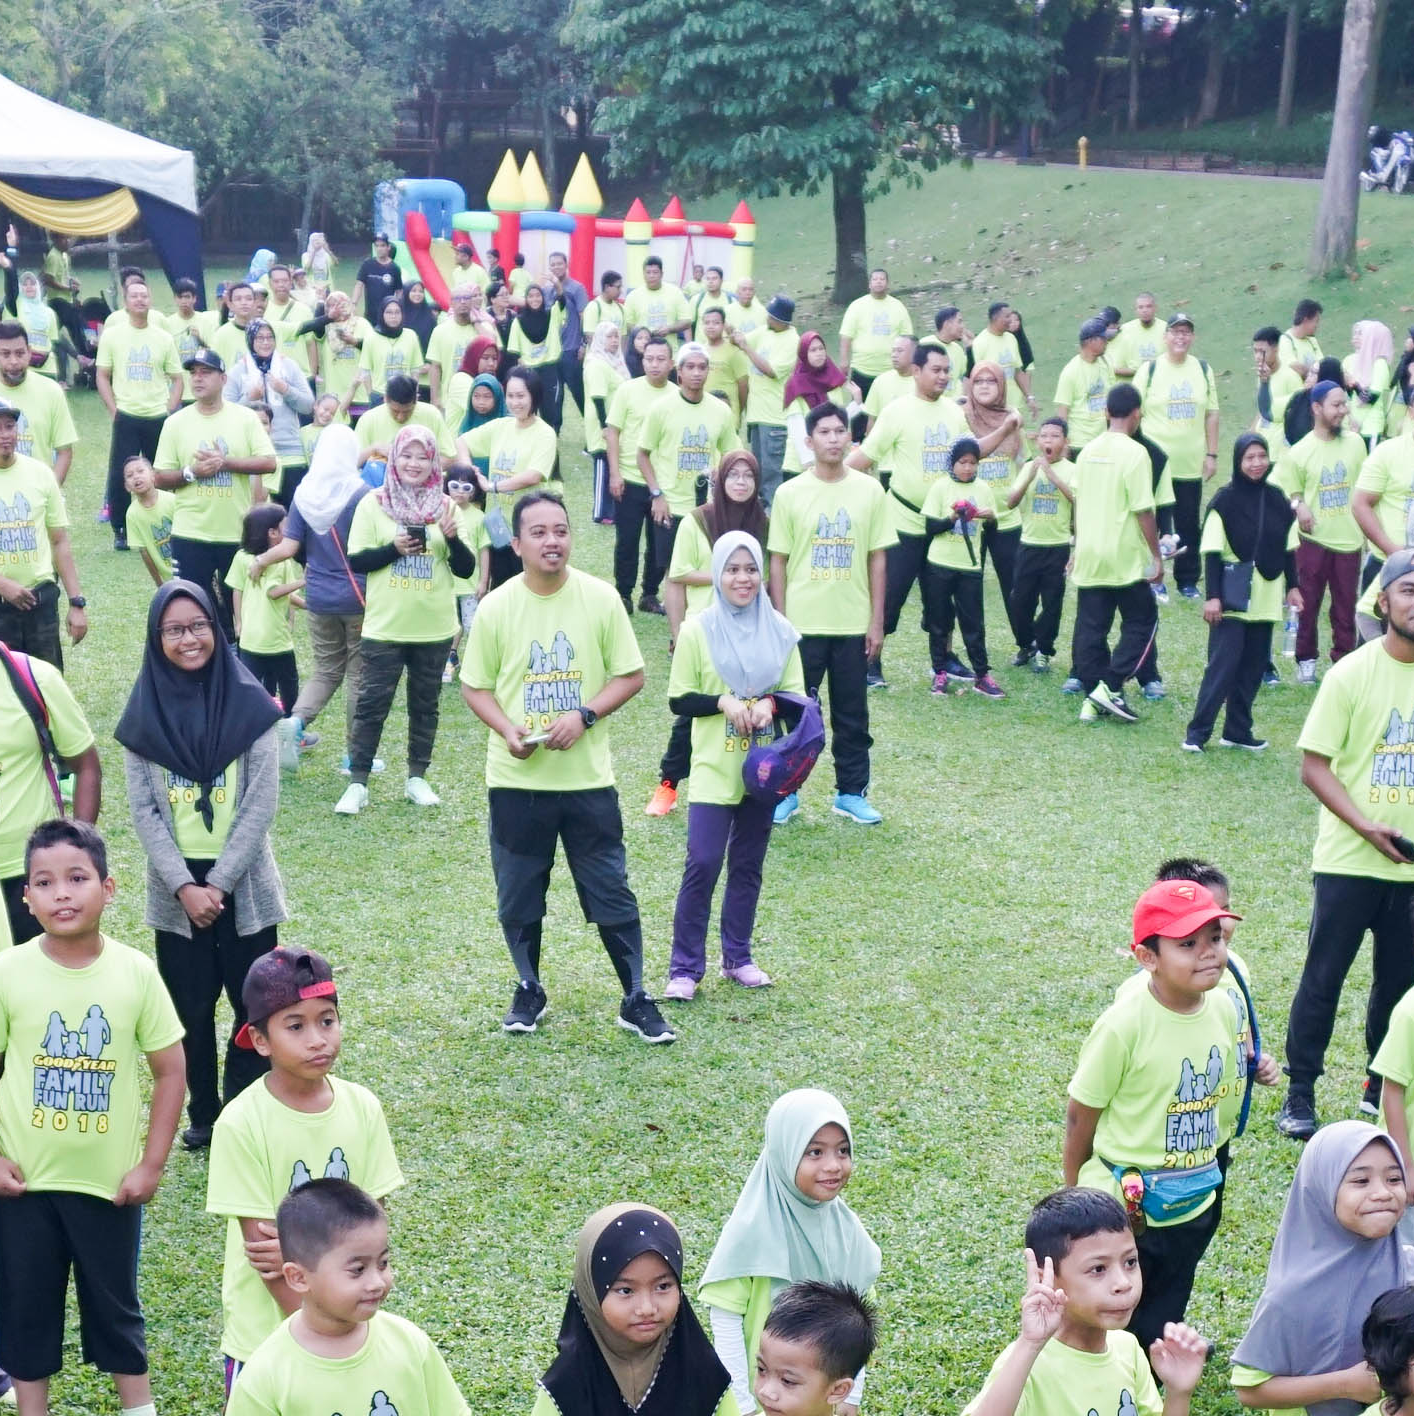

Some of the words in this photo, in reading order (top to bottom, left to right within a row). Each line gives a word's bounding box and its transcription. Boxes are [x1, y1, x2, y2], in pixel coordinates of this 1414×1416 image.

[812, 544, 856, 560] FAMILY
[523, 670, 583, 683] GOODYEAR
[524, 679, 583, 702] FAMILY
[525, 697, 551, 714] FUN
[553, 695, 581, 712] RUN
[1371, 768, 1401, 788] FUN
[167, 788, 227, 804] 208
[33, 1055, 117, 1073] GOODYEAR
[34, 1067, 116, 1096] FAMILY
[34, 1088, 69, 1111] FUN
[72, 1091, 110, 1113] RUN
[31, 1107, 110, 1134] 2018
[1165, 1133, 1198, 1153] FUN
